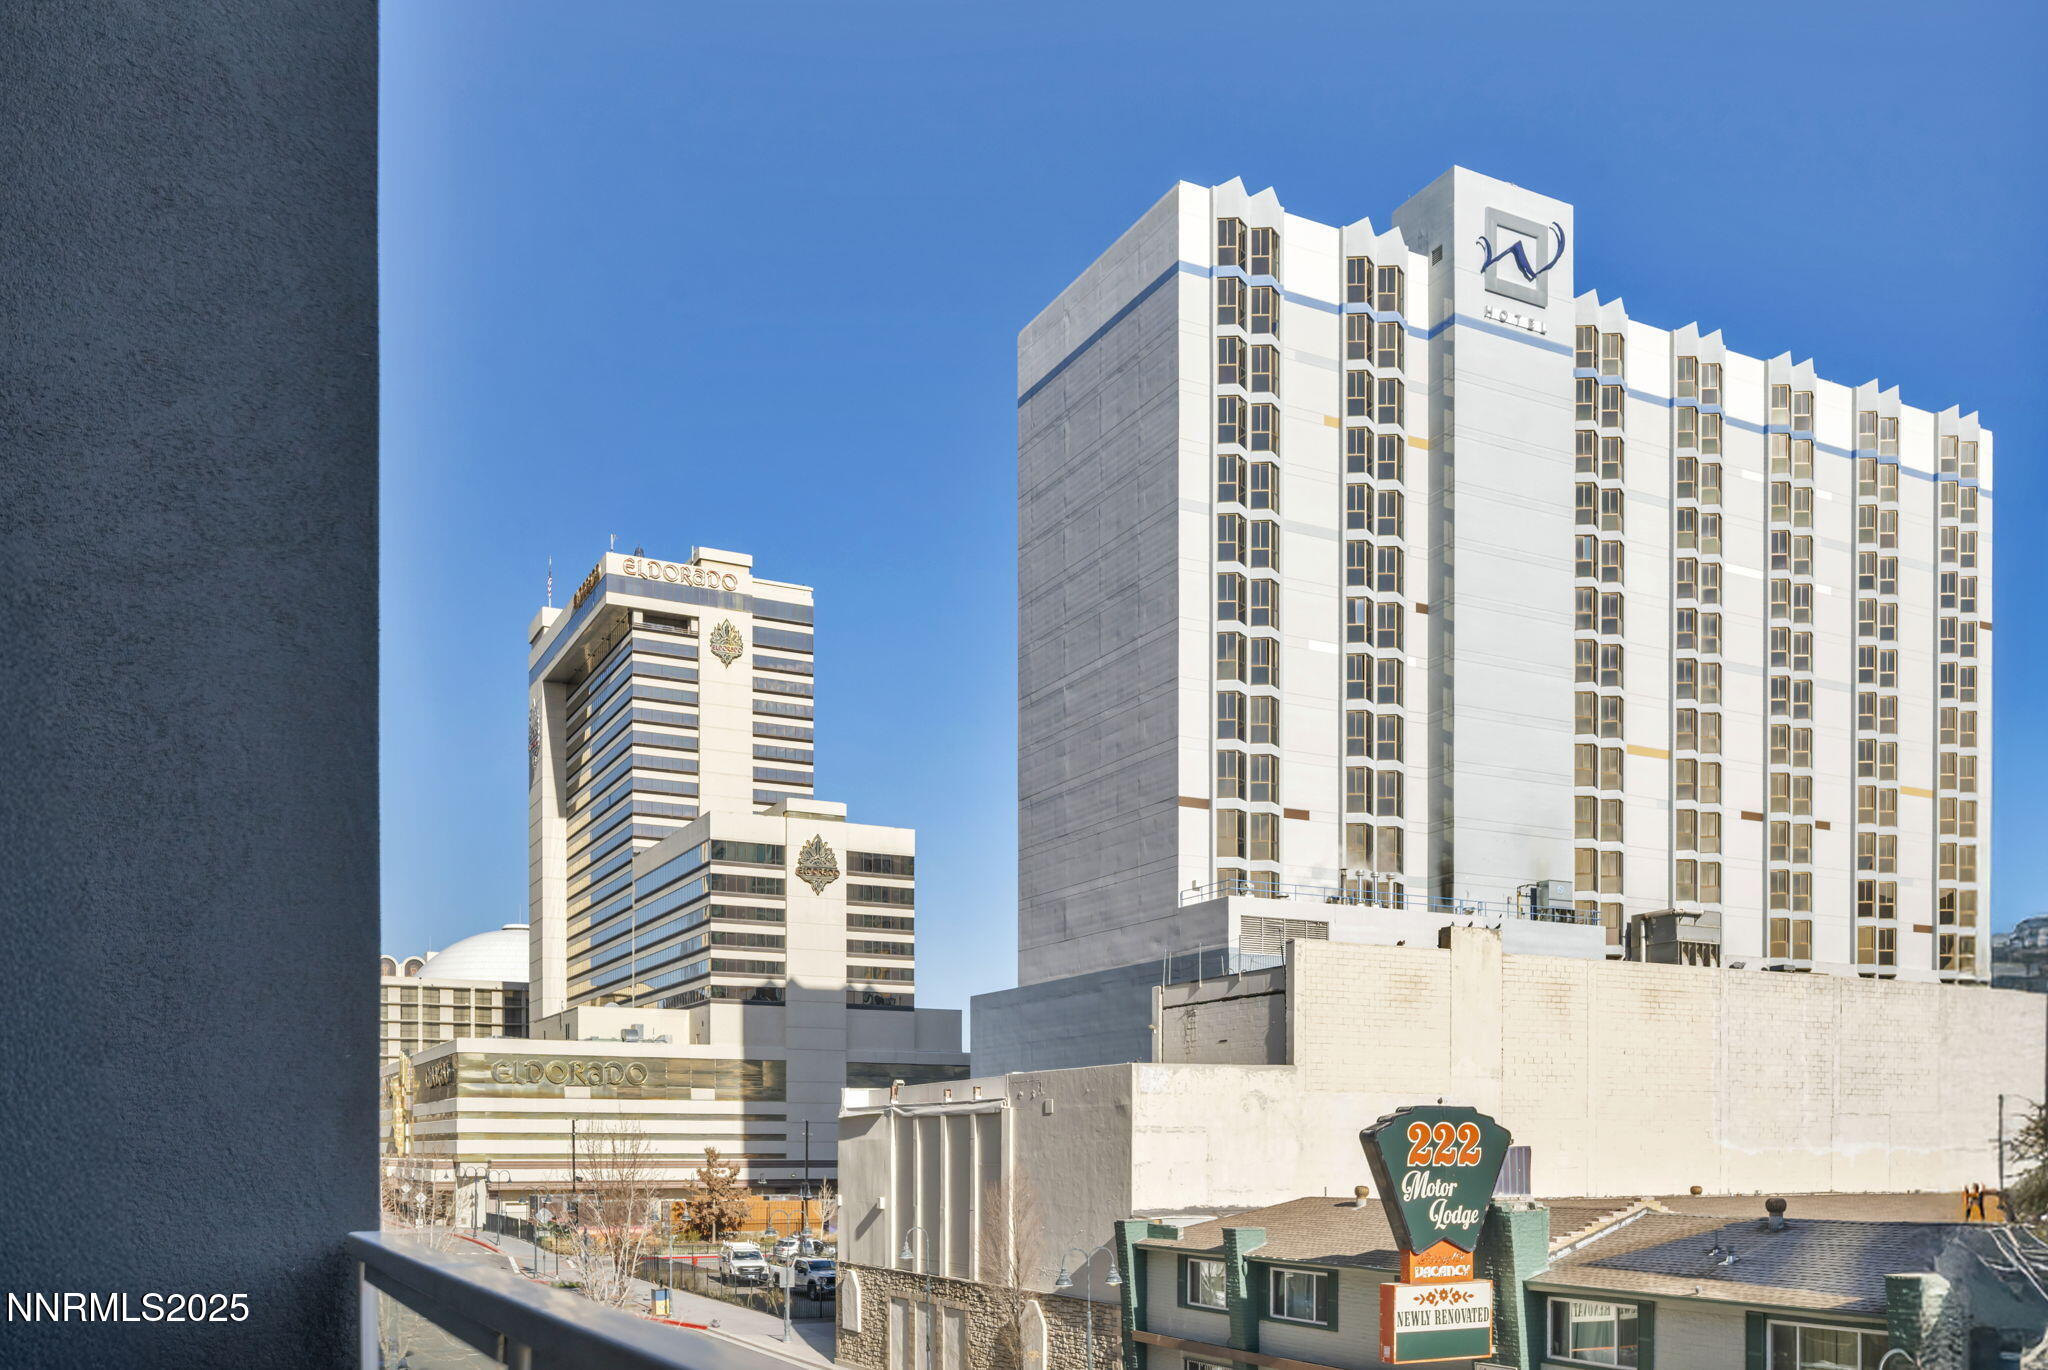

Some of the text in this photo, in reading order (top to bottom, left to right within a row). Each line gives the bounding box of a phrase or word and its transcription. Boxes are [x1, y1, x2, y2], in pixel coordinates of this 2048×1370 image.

[1484, 304, 1548, 335] HOTEL
[1407, 1121, 1482, 1167] 222
[1401, 1170, 1458, 1202] Motor
[1429, 1198, 1480, 1231] Lodge
[1397, 1306, 1490, 1327] NEWLY RENOVATED
